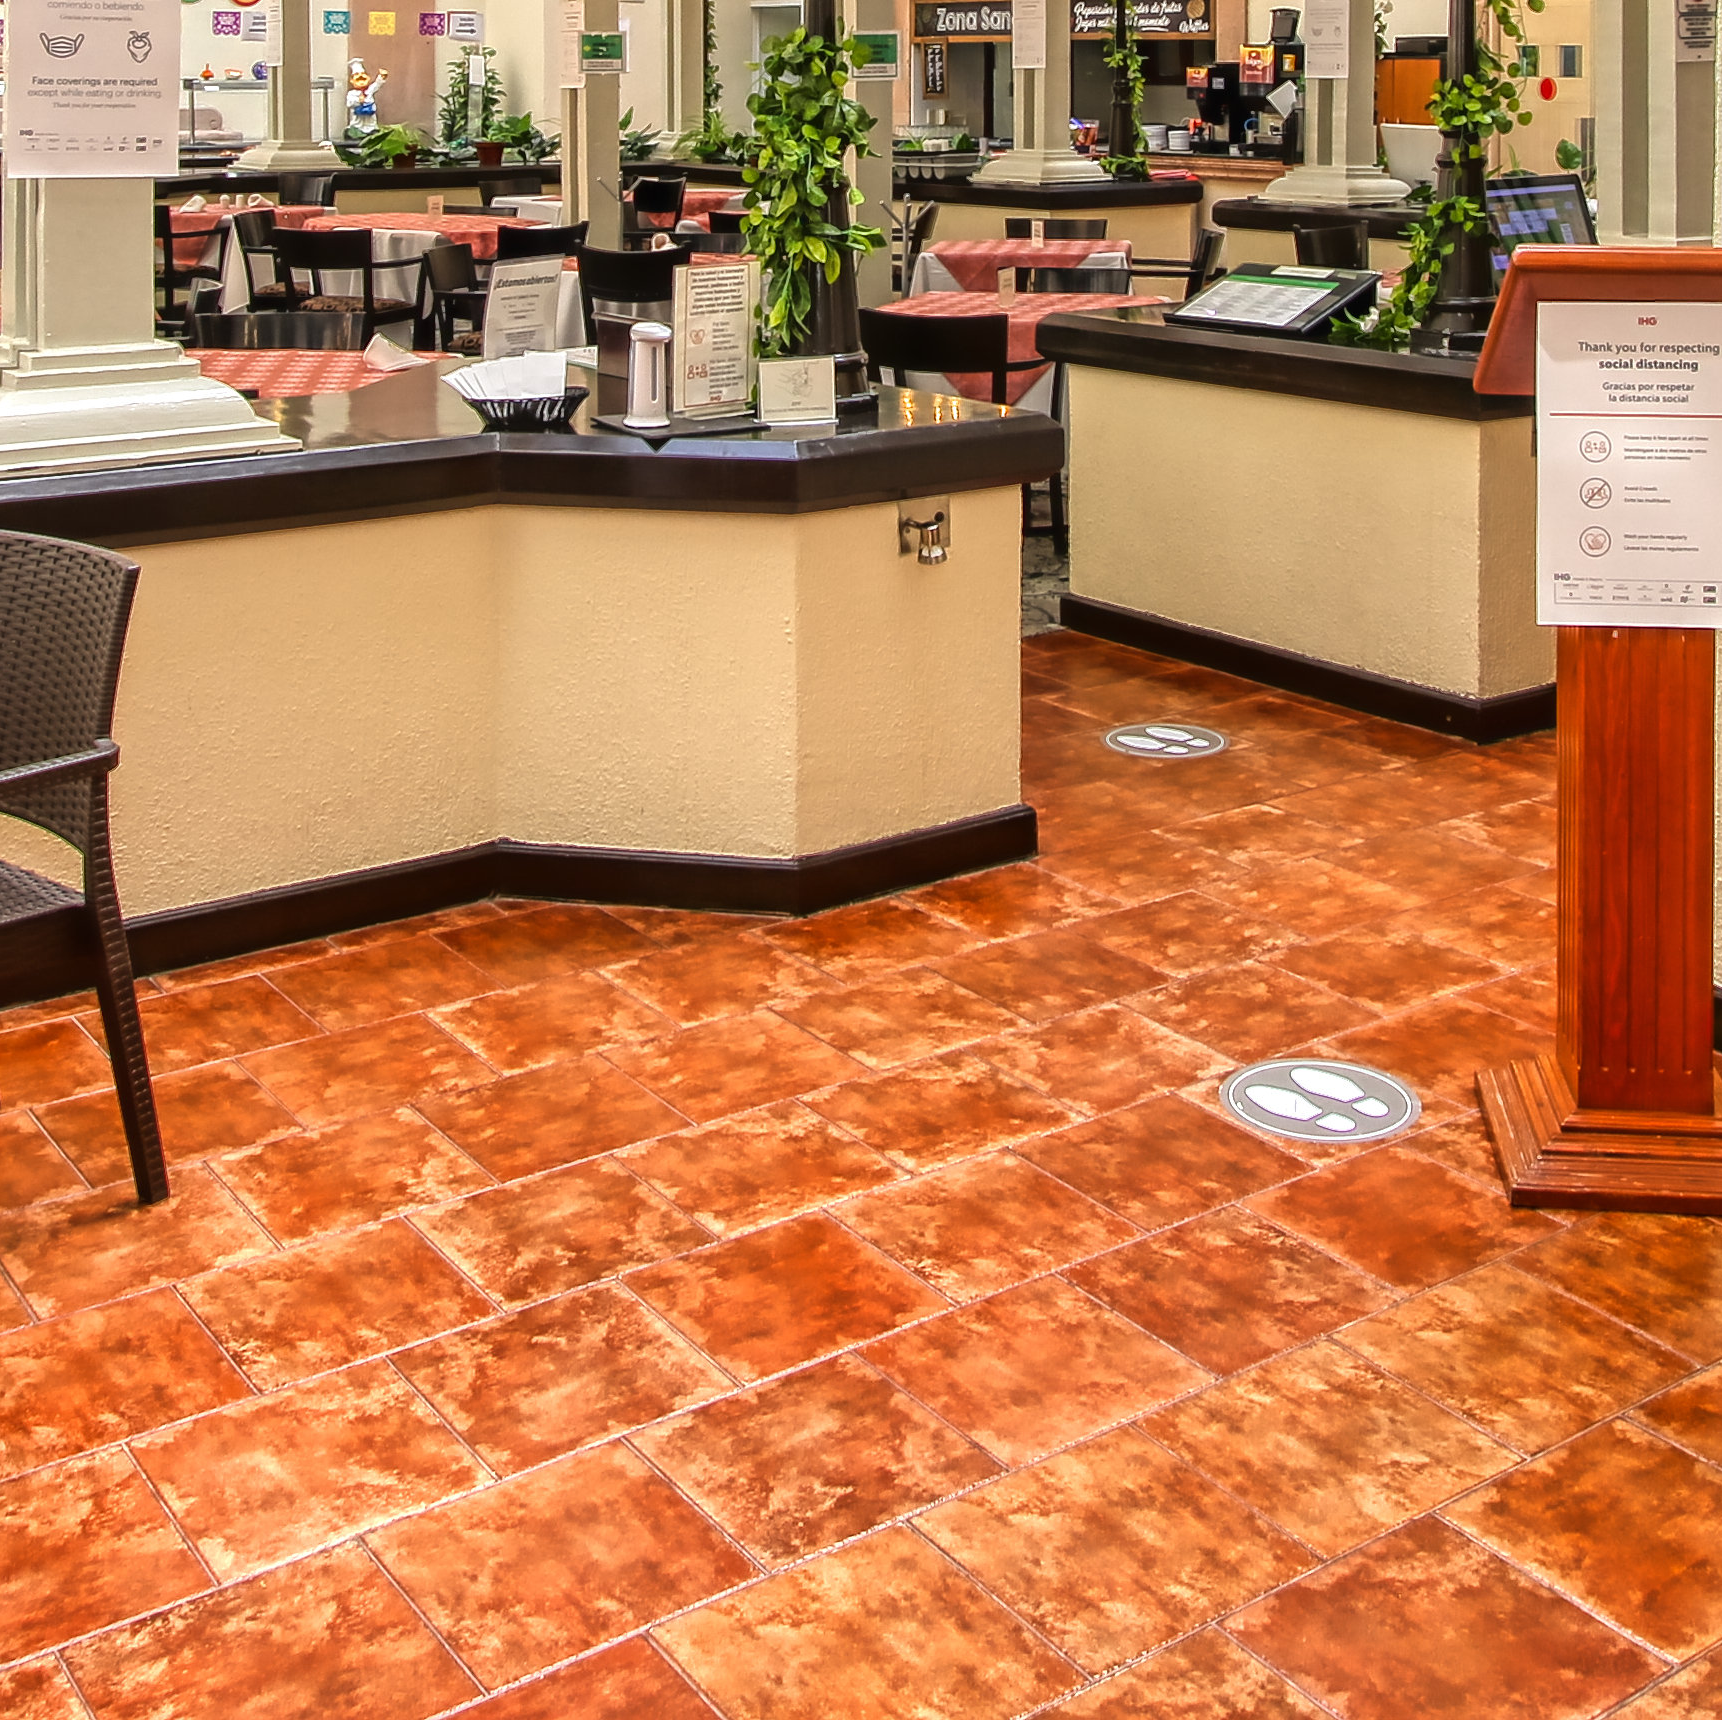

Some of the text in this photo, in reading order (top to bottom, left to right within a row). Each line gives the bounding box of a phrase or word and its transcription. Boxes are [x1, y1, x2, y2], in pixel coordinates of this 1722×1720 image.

[48, 1, 93, 9] comiendo
[937, 6, 1011, 31] Zona San
[32, 76, 54, 85] Face
[56, 77, 101, 87] coverings
[120, 78, 158, 87] required
[27, 89, 58, 97] except
[61, 89, 84, 97] while
[85, 90, 113, 99] eating
[1638, 317, 1657, 326] IHG
[1578, 342, 1720, 356] Thank you for respecting
[1599, 359, 1699, 372] social distancing
[1602, 382, 1695, 394] Gracias por respetar
[1609, 394, 1689, 403] la distancia social
